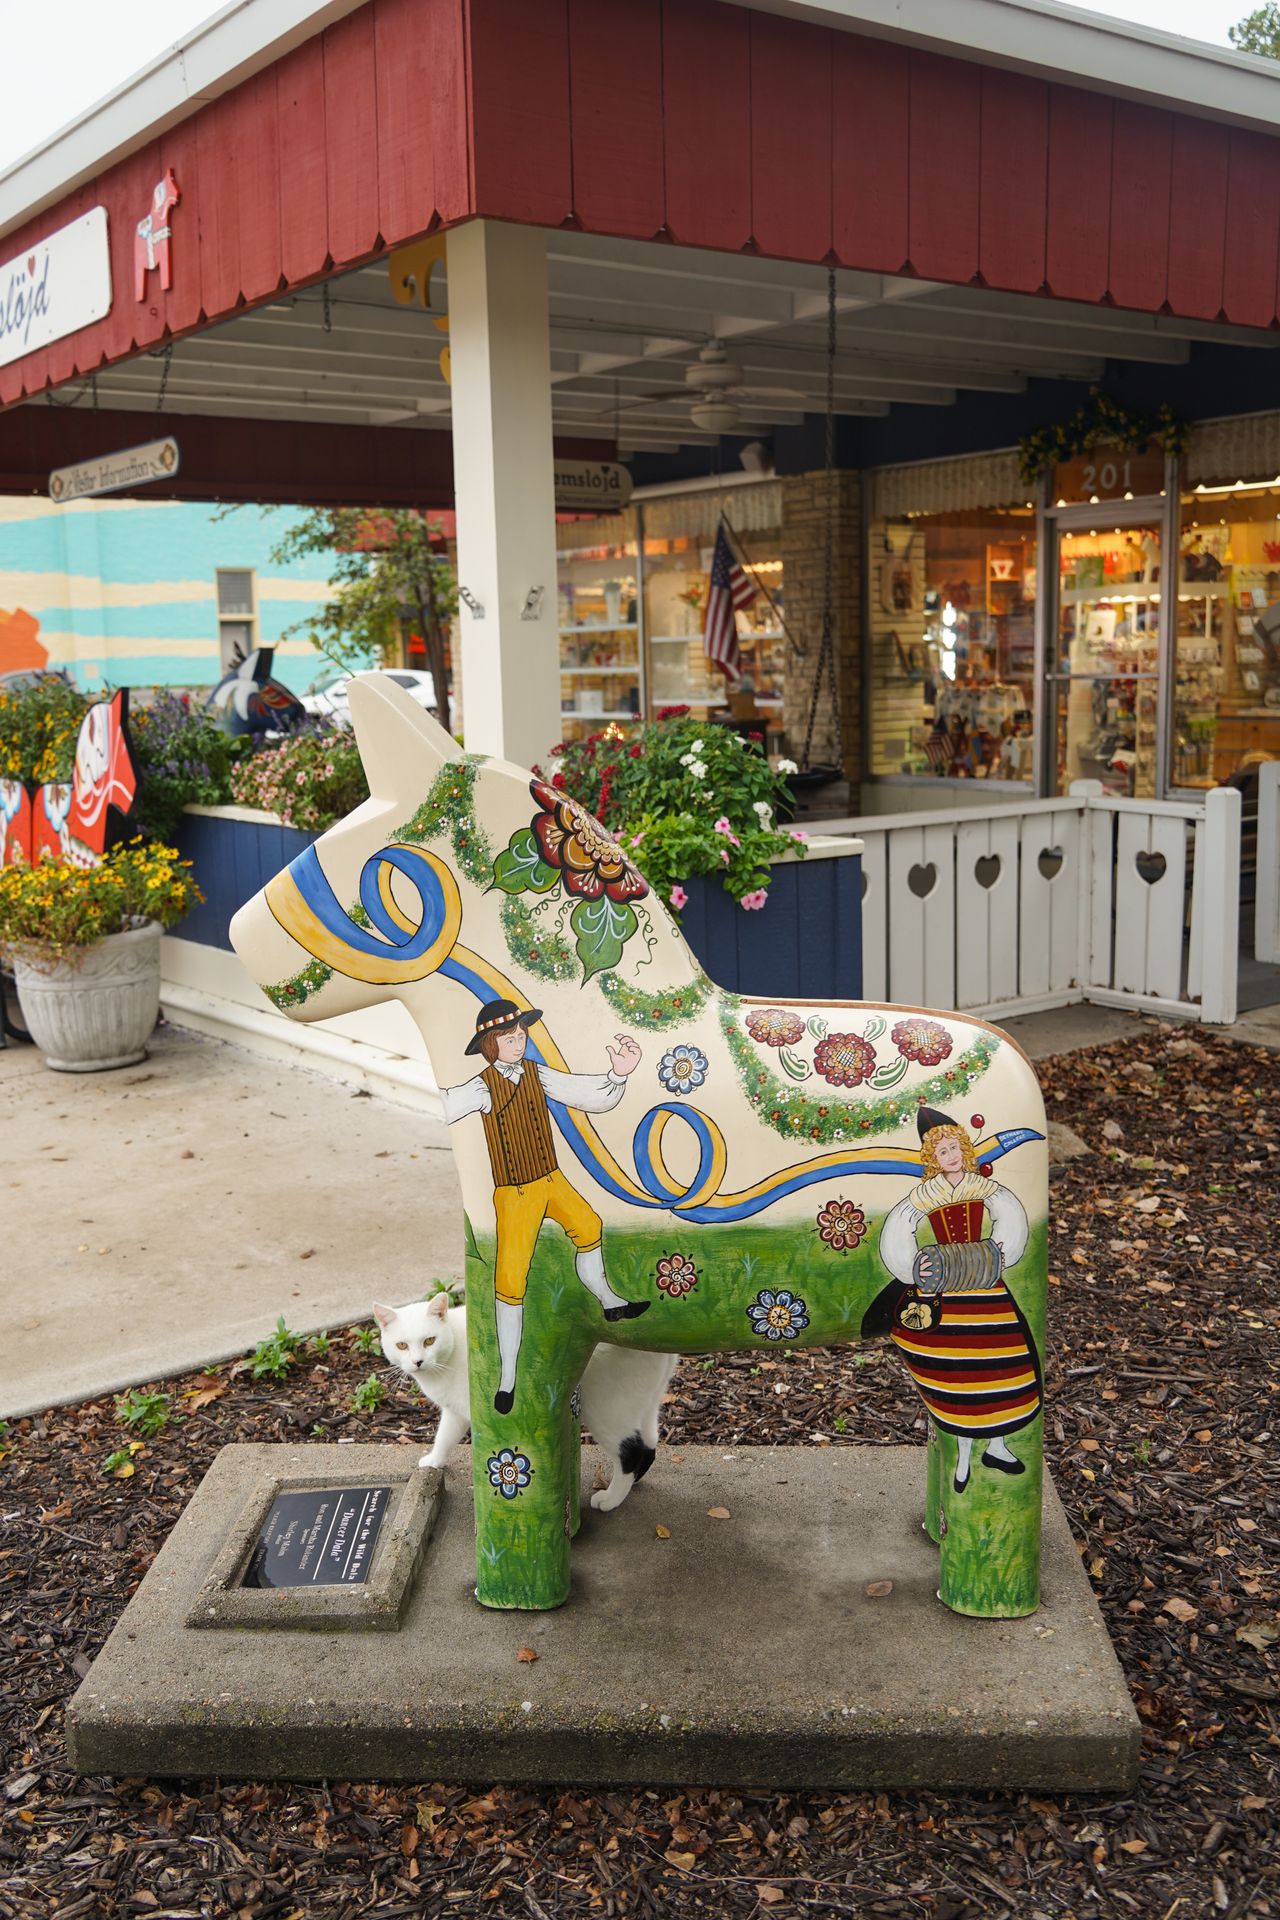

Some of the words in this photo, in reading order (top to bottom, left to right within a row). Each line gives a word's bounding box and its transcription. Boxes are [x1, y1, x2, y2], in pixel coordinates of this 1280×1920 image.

[1081, 461, 1131, 491] 201
[369, 1490, 382, 1512] Search
[365, 1515, 375, 1526] for
[360, 1529, 370, 1540] the
[355, 1543, 366, 1559] Wild
[348, 1562, 360, 1579] Dala
